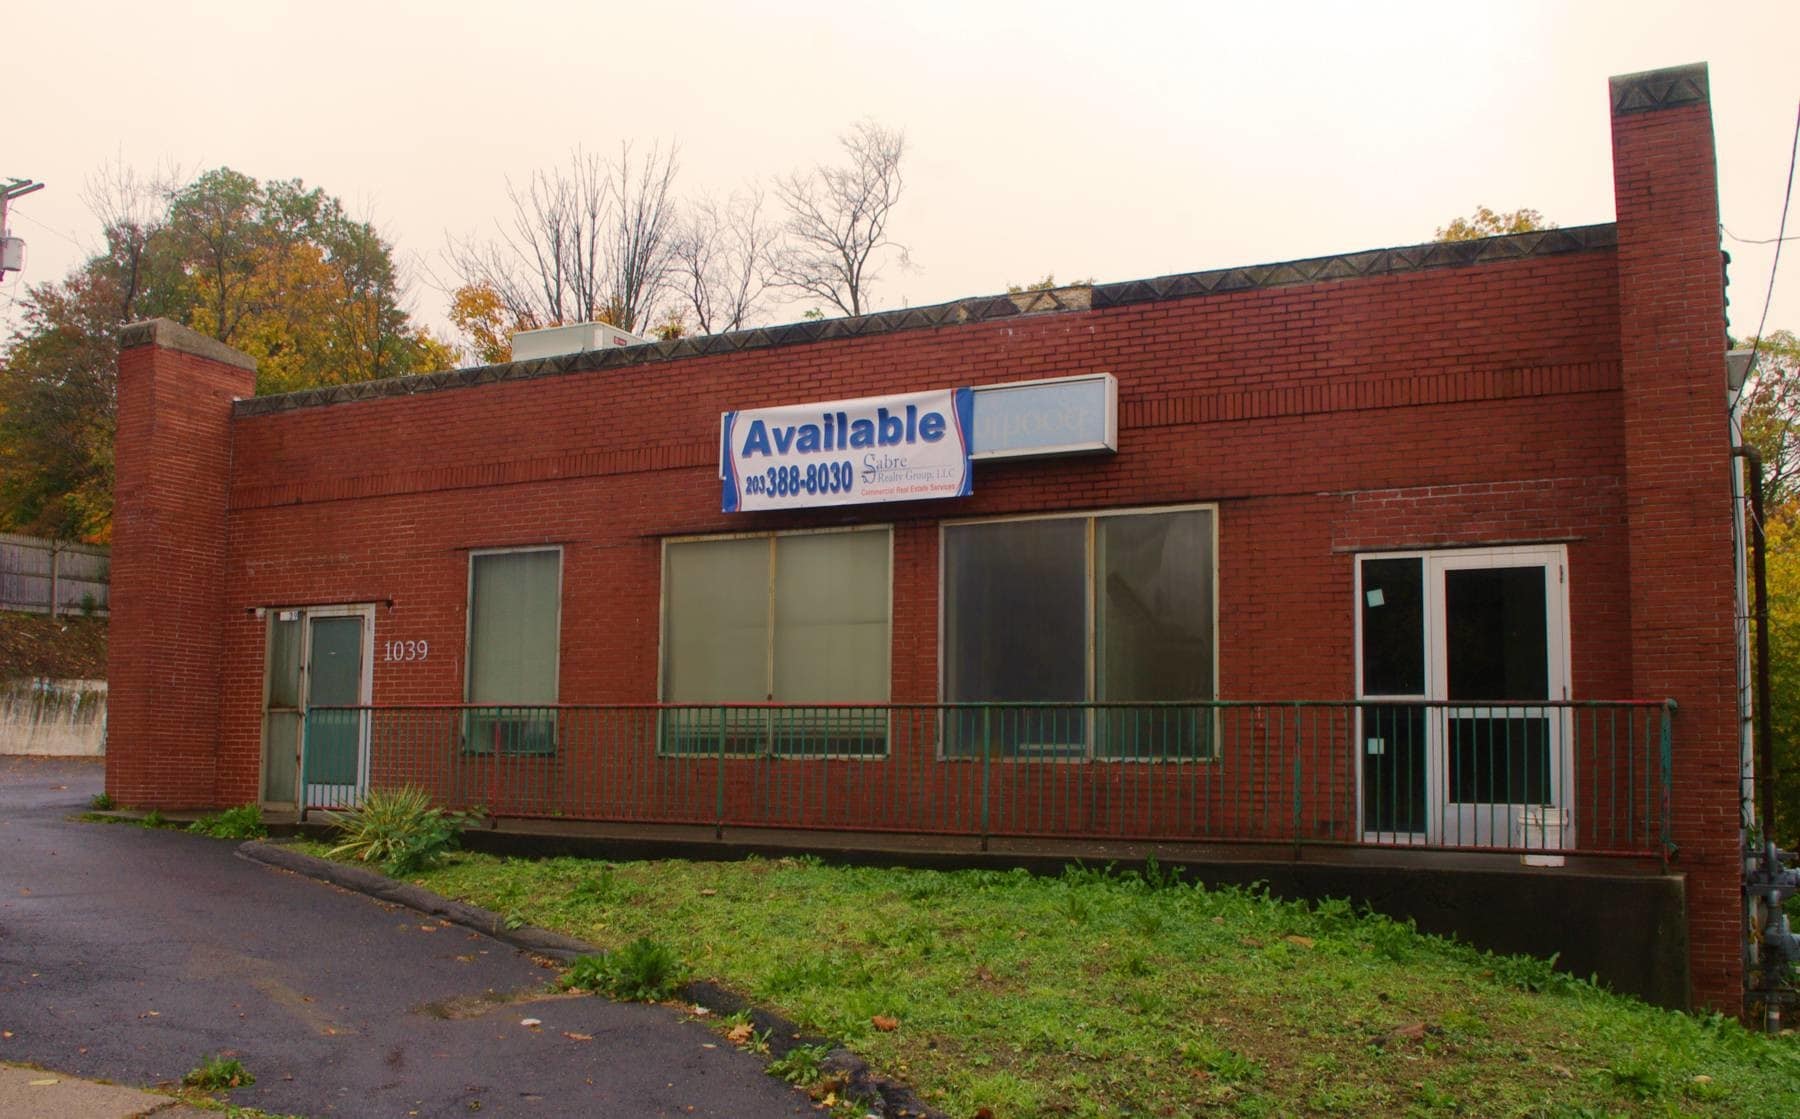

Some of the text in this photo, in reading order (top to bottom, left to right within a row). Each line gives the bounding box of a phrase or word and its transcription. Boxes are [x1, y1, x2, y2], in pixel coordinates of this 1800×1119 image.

[741, 404, 947, 459] Available
[861, 453, 908, 484] Sabre
[878, 470, 903, 483] Realty
[860, 486, 895, 496] Commercial
[896, 485, 909, 494] Real
[930, 482, 956, 491] Services
[383, 639, 429, 662] 1039
